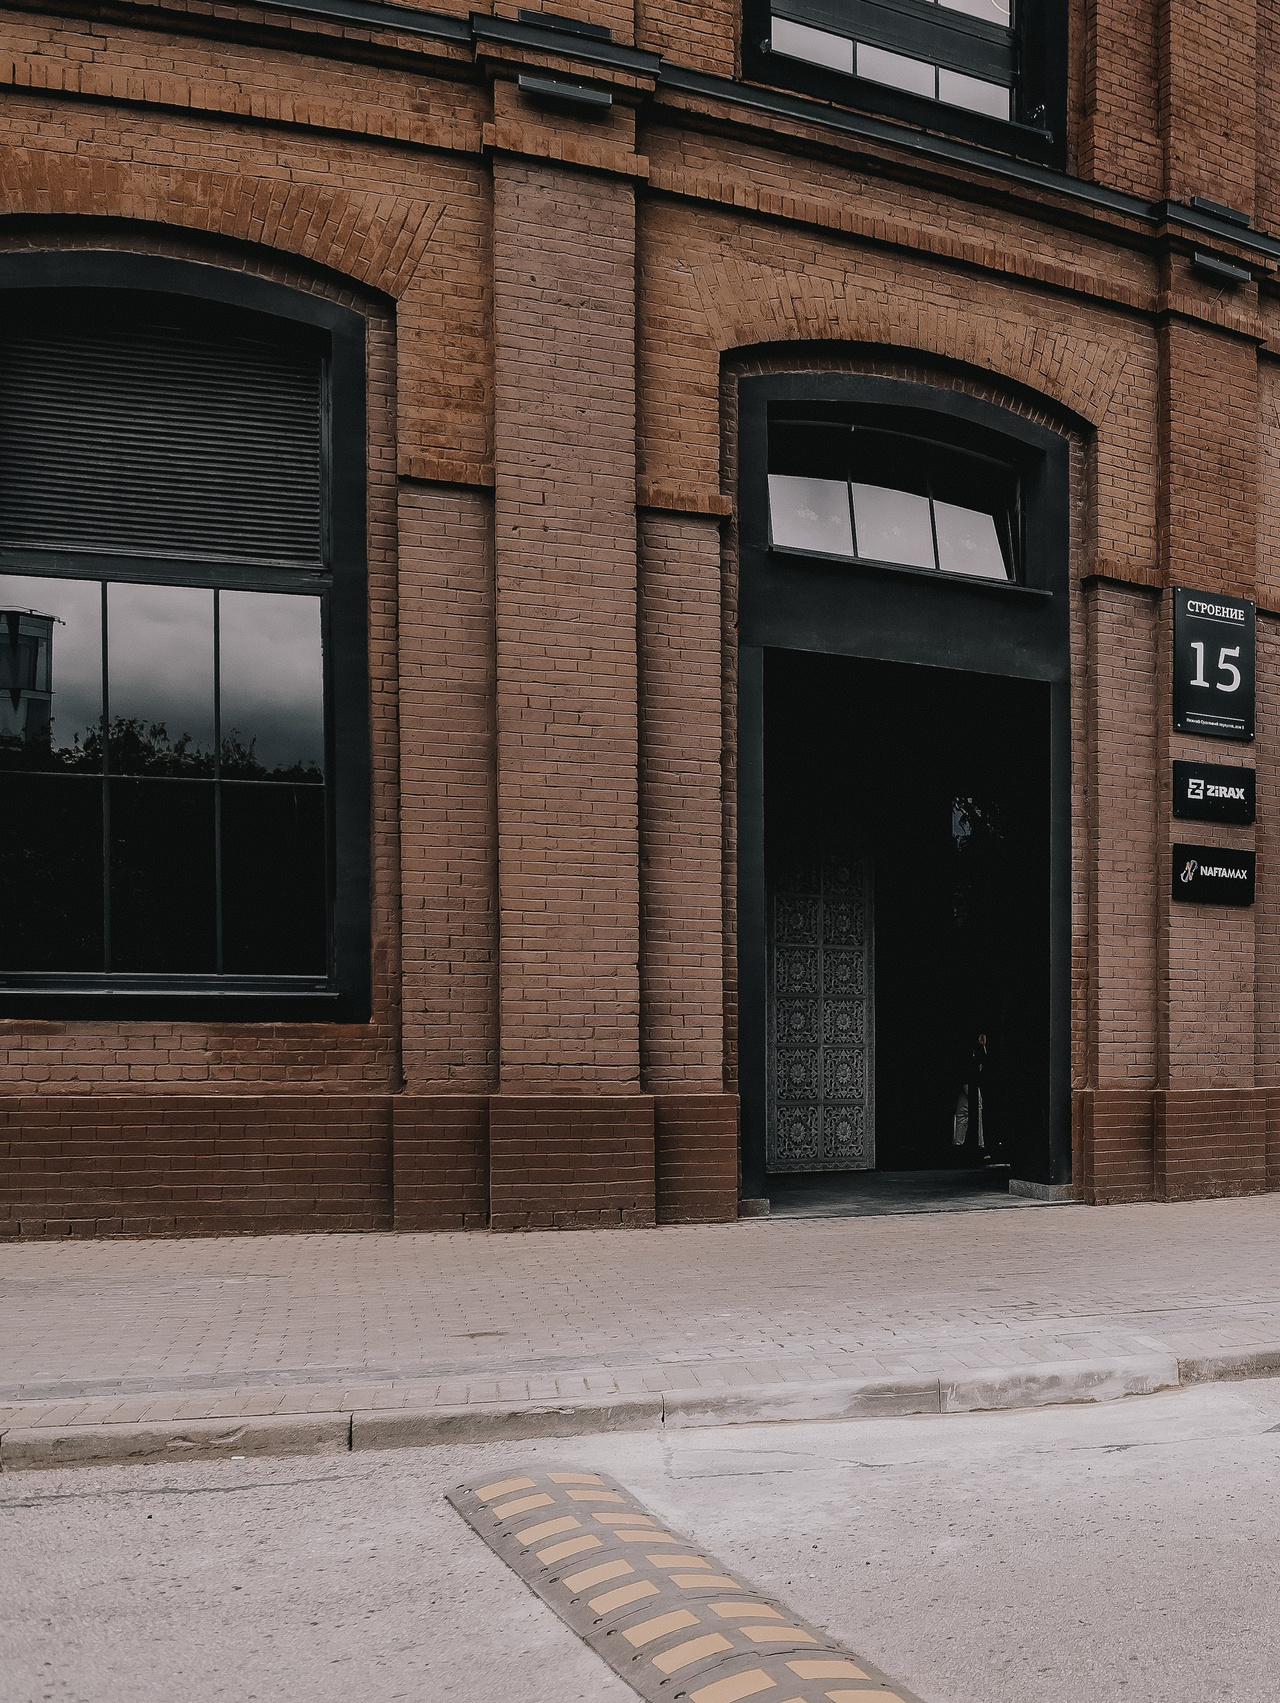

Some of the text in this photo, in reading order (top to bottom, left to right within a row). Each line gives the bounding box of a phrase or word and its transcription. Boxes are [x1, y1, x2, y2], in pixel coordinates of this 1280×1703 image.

[1187, 600, 1245, 621] СТРОЕНИЕ
[1190, 641, 1241, 693] 15
[1200, 865, 1248, 880] NAFTAMAX
